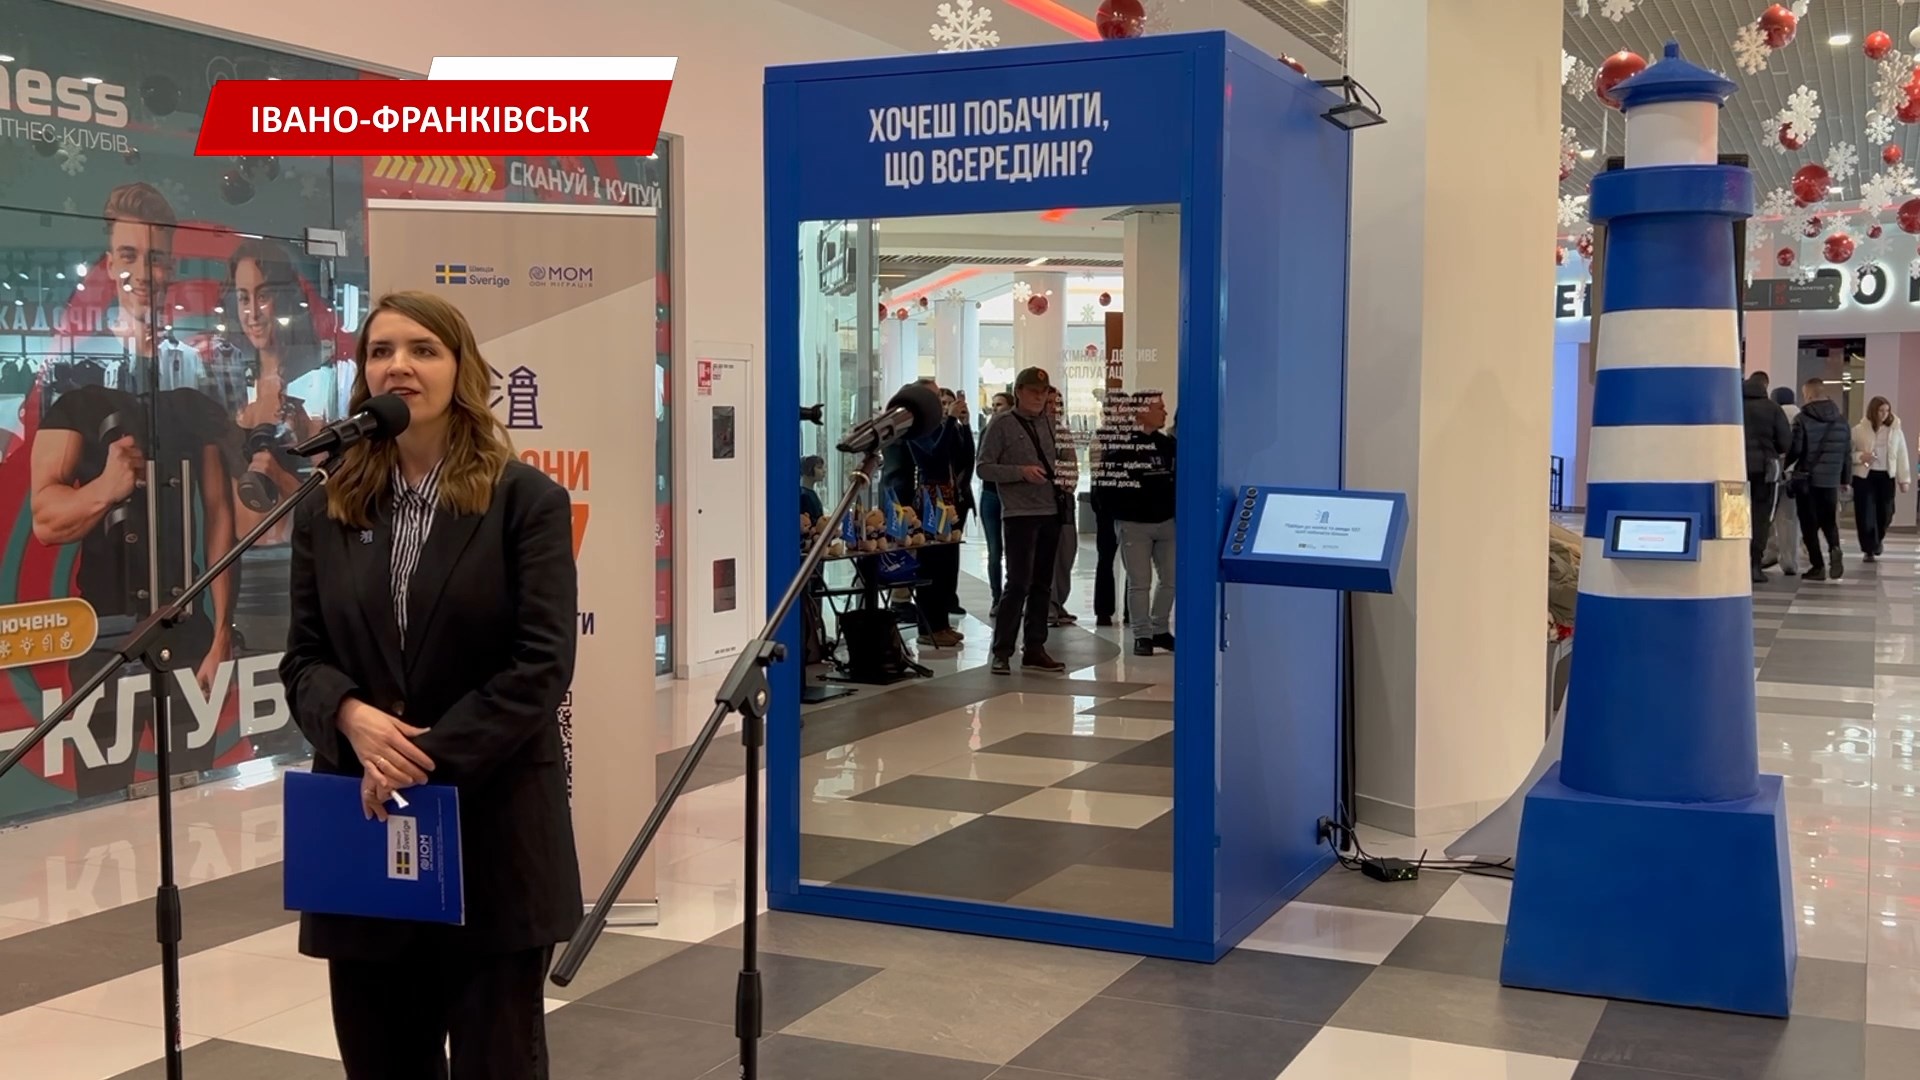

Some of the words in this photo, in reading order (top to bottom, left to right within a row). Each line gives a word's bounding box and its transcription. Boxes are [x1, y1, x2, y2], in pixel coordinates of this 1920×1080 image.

[0, 65, 128, 128] ess
[868, 102, 956, 143] ХОЧЕШ
[963, 91, 1109, 137] ПОБАЧИТИ,
[884, 151, 925, 189] ЩО
[932, 139, 1093, 184] ВСЕРЕДИНІ?
[510, 161, 588, 197] СКАНУЙ
[605, 178, 663, 209] КУПУЙ
[469, 274, 510, 288] Sverige
[548, 266, 593, 281] МОМ
[0, 613, 68, 635] ючень
[402, 819, 412, 850] Sverige
[419, 834, 430, 858] IOM
